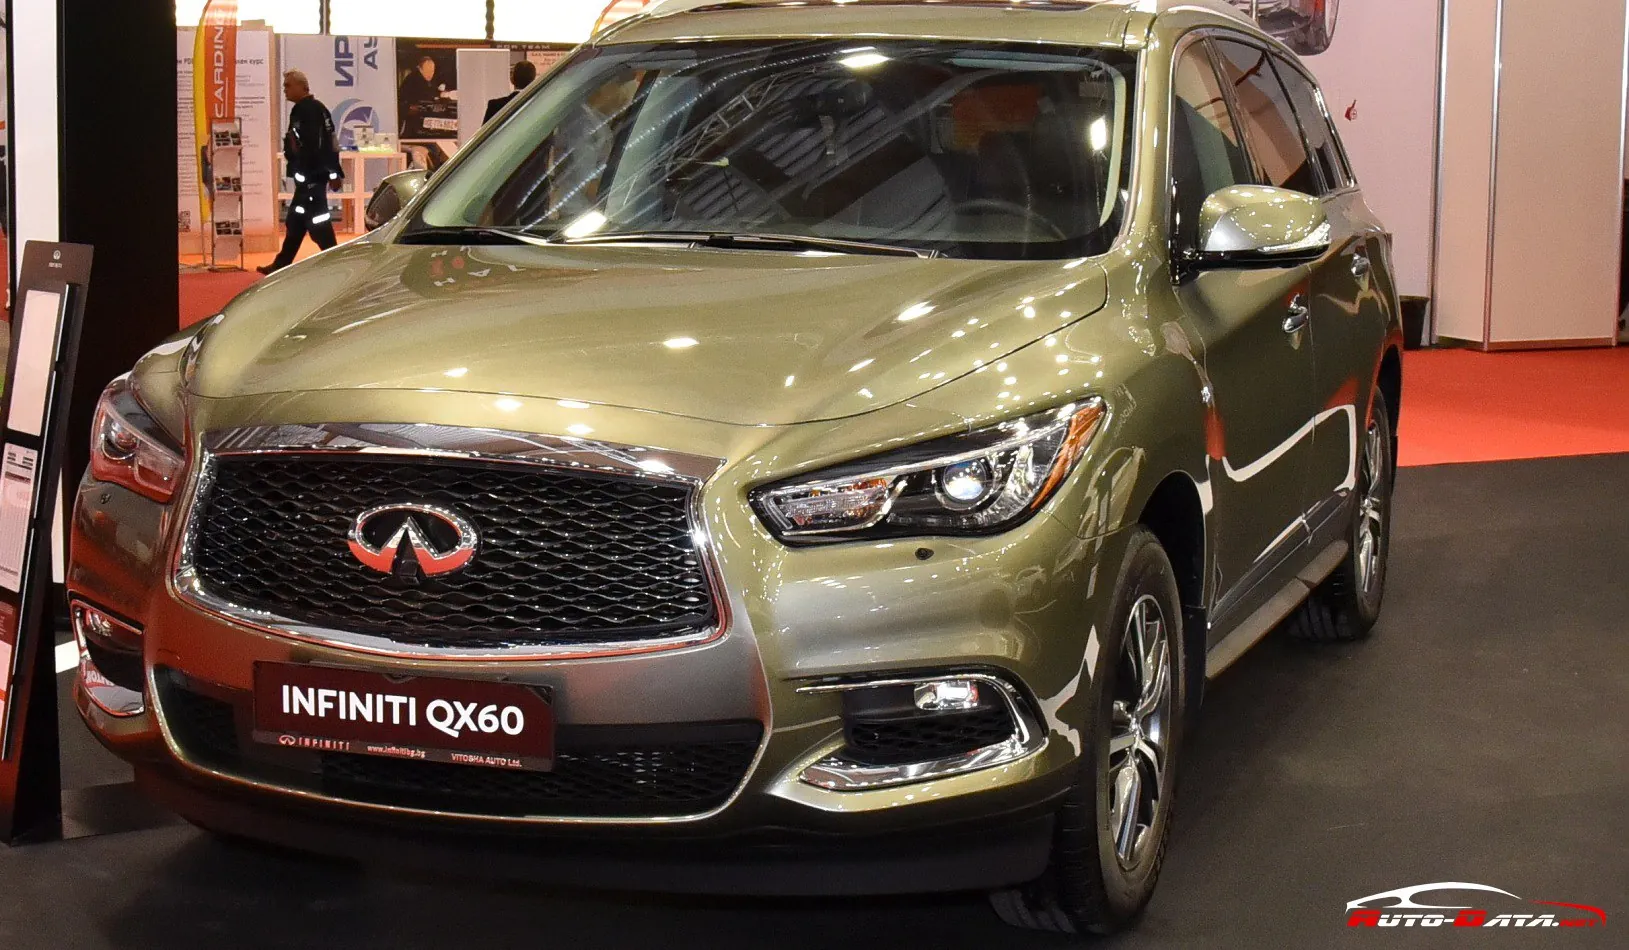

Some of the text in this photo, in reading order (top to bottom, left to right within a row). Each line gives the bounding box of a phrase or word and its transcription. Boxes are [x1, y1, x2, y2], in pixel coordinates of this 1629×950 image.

[282, 684, 525, 738] INFINITI QX60
[298, 736, 351, 751] INFINITI
[367, 744, 426, 759] www.infinitibg.bg
[451, 753, 484, 764] VITOSHA
[485, 755, 507, 766] AUTO
